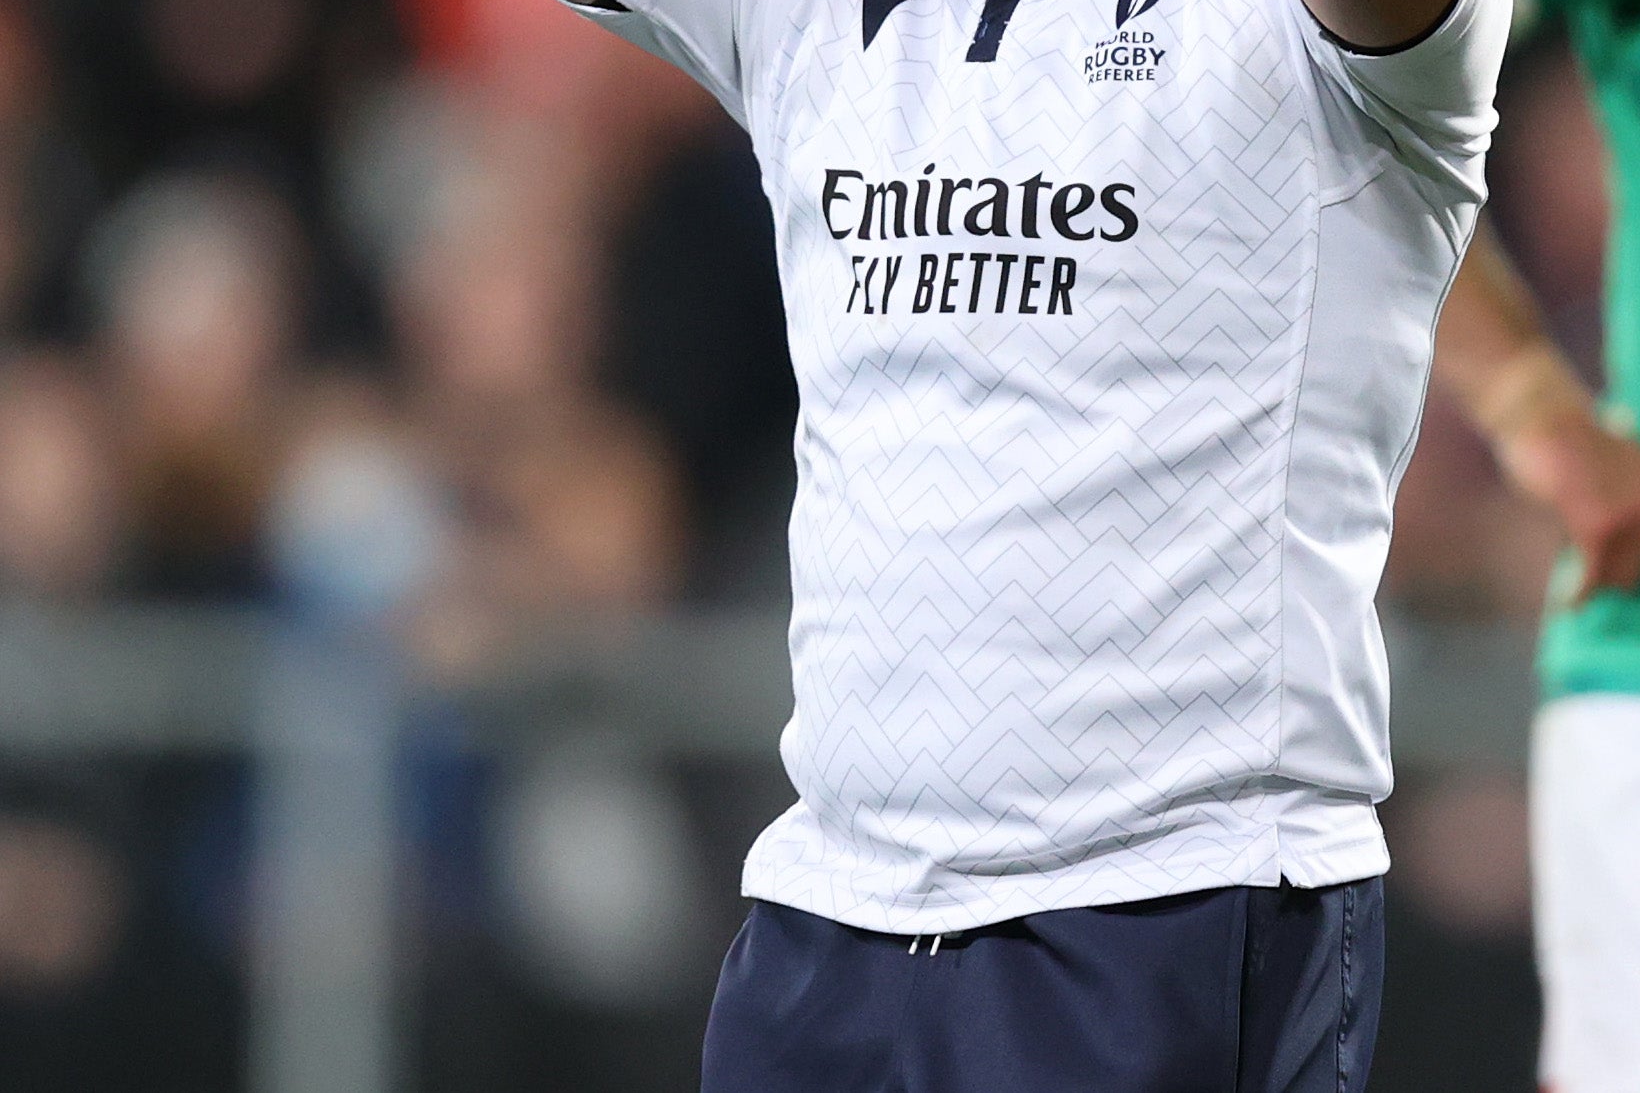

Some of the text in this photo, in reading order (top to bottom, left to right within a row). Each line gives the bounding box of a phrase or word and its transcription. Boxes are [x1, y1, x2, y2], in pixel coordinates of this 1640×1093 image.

[1095, 31, 1155, 49] RLD
[1084, 46, 1166, 75] RUGBY
[1087, 68, 1156, 84] REFEREE
[821, 162, 1139, 243] Emirates
[846, 252, 1077, 316] FLY BETTER
